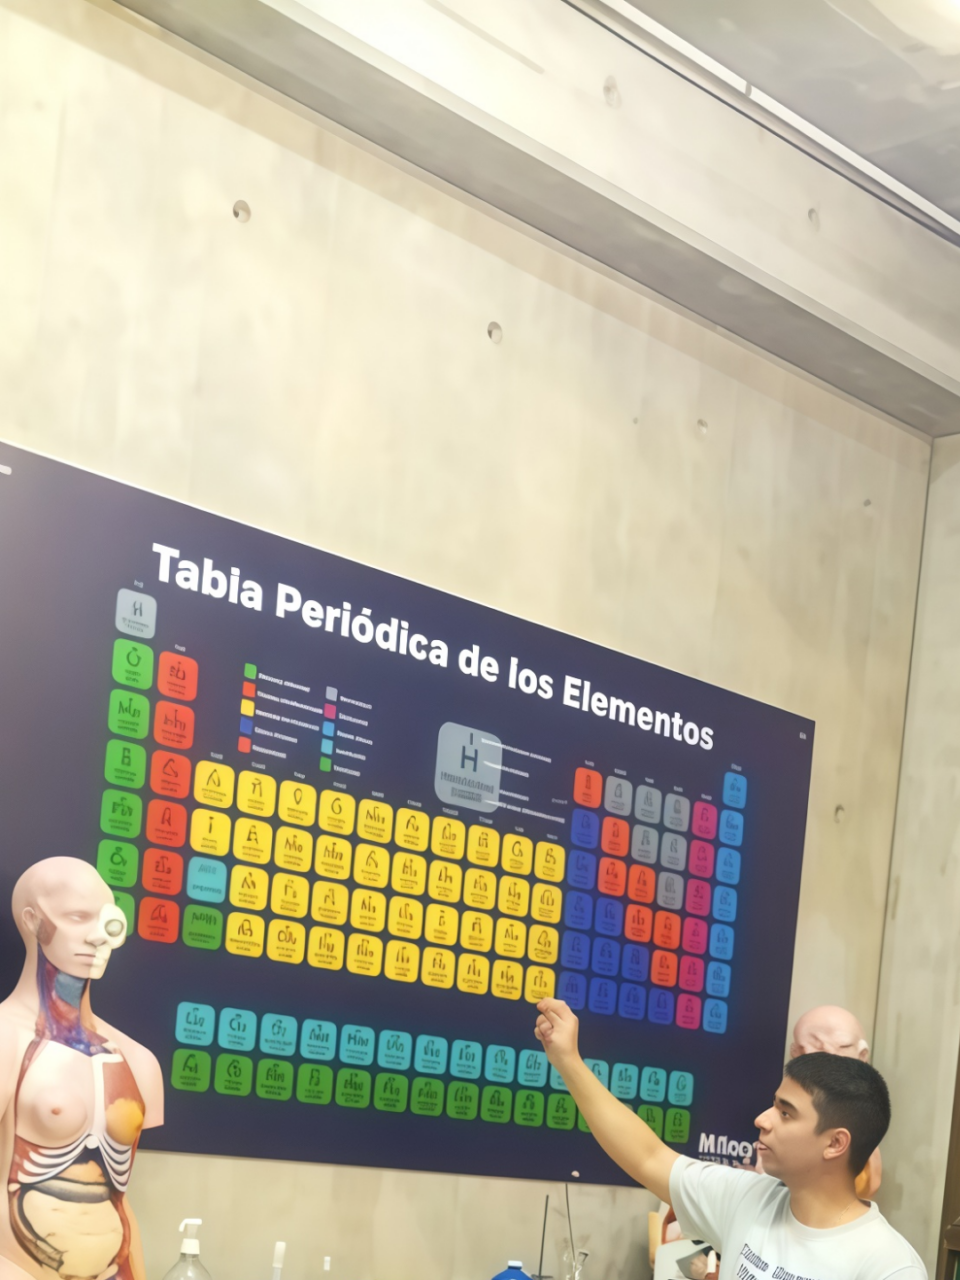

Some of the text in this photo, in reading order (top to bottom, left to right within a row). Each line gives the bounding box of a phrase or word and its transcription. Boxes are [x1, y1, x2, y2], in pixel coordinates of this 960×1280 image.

[275, 583, 449, 667] Periódica
[458, 644, 500, 683] de
[508, 656, 554, 700] los
[562, 675, 714, 750] Elementos
[460, 745, 479, 773] H
